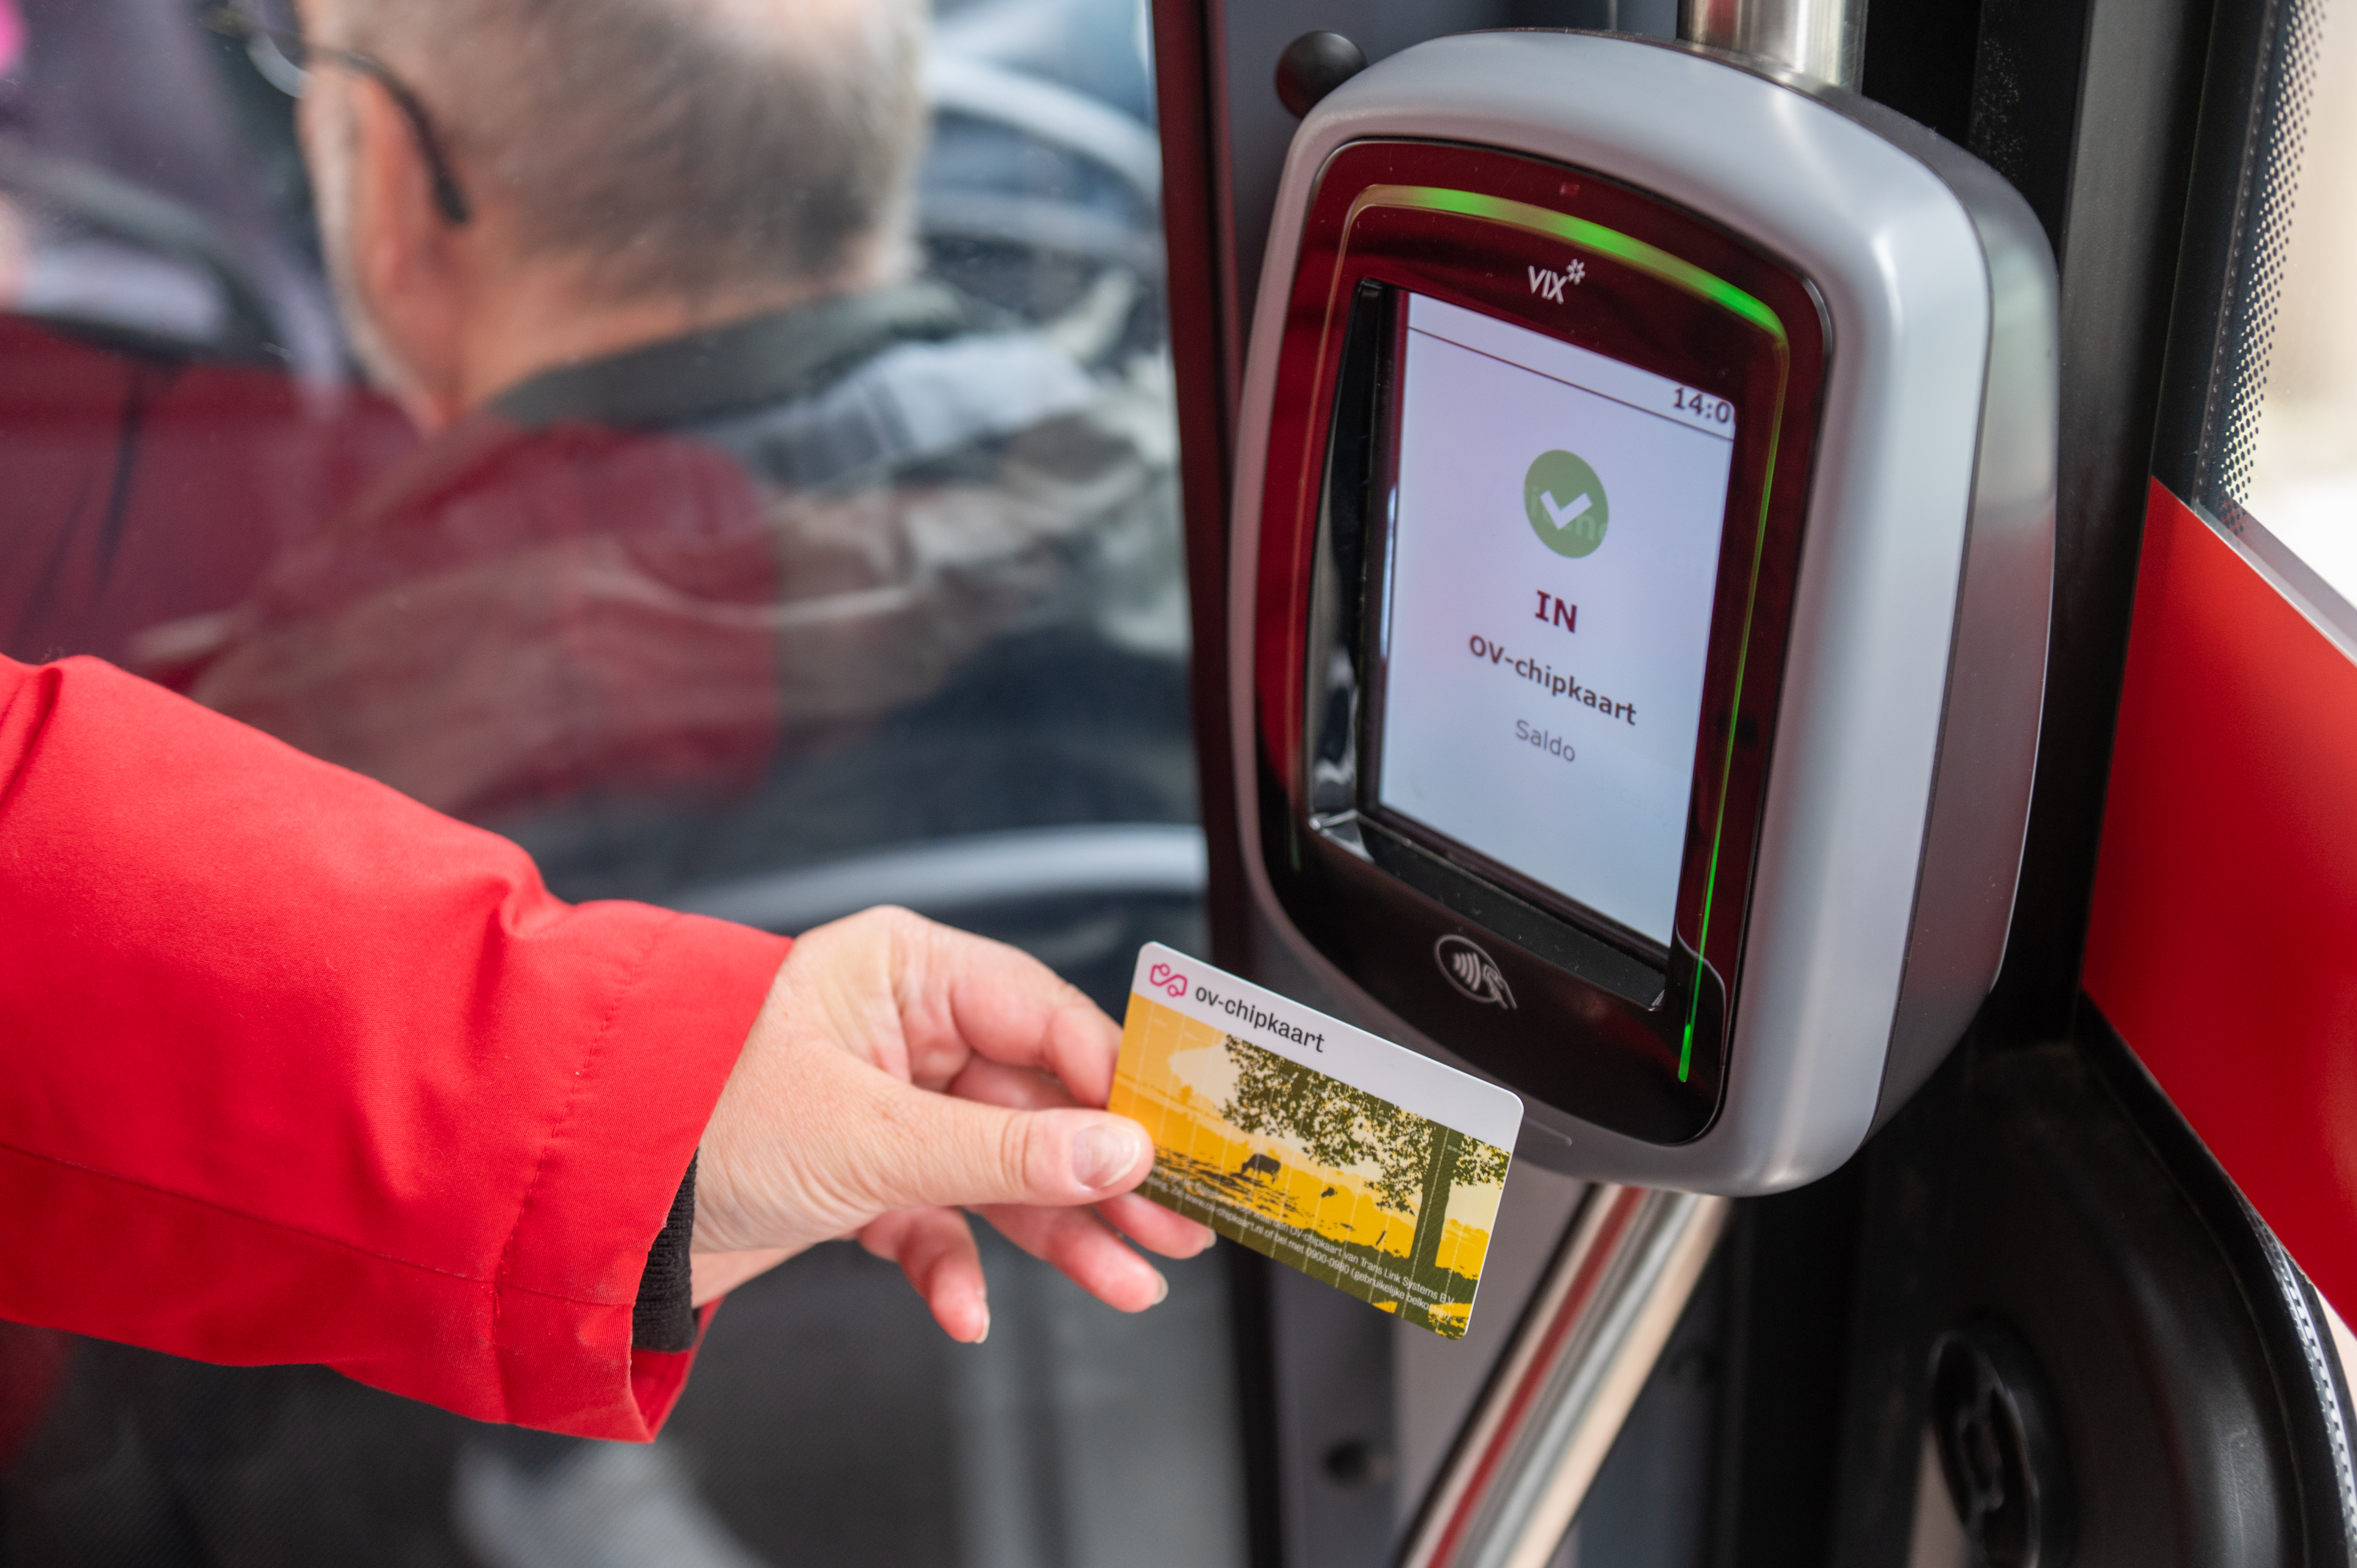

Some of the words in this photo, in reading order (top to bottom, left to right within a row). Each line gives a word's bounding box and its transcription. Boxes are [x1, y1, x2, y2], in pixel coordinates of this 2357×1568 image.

[1673, 387, 1735, 423] 14:0
[1535, 589, 1577, 633] IN
[1469, 634, 1636, 725] OV-chipkaart
[1516, 719, 1575, 762] Saldo
[1195, 986, 1325, 1052] ov-chipkaart
[1264, 1230, 1274, 1239] of
[1274, 1232, 1288, 1245] bel
[1288, 1241, 1305, 1254] met
[1306, 1247, 1350, 1274] 0900-0980
[1350, 1268, 1405, 1299] (gebruikelijke
[1290, 1225, 1342, 1256] OV-chipkaart
[1345, 1252, 1358, 1264] van
[1361, 1257, 1383, 1275] Trans
[1384, 1268, 1401, 1283] Link
[1402, 1277, 1438, 1300] Systems
[1440, 1293, 1455, 1307] B.V.
